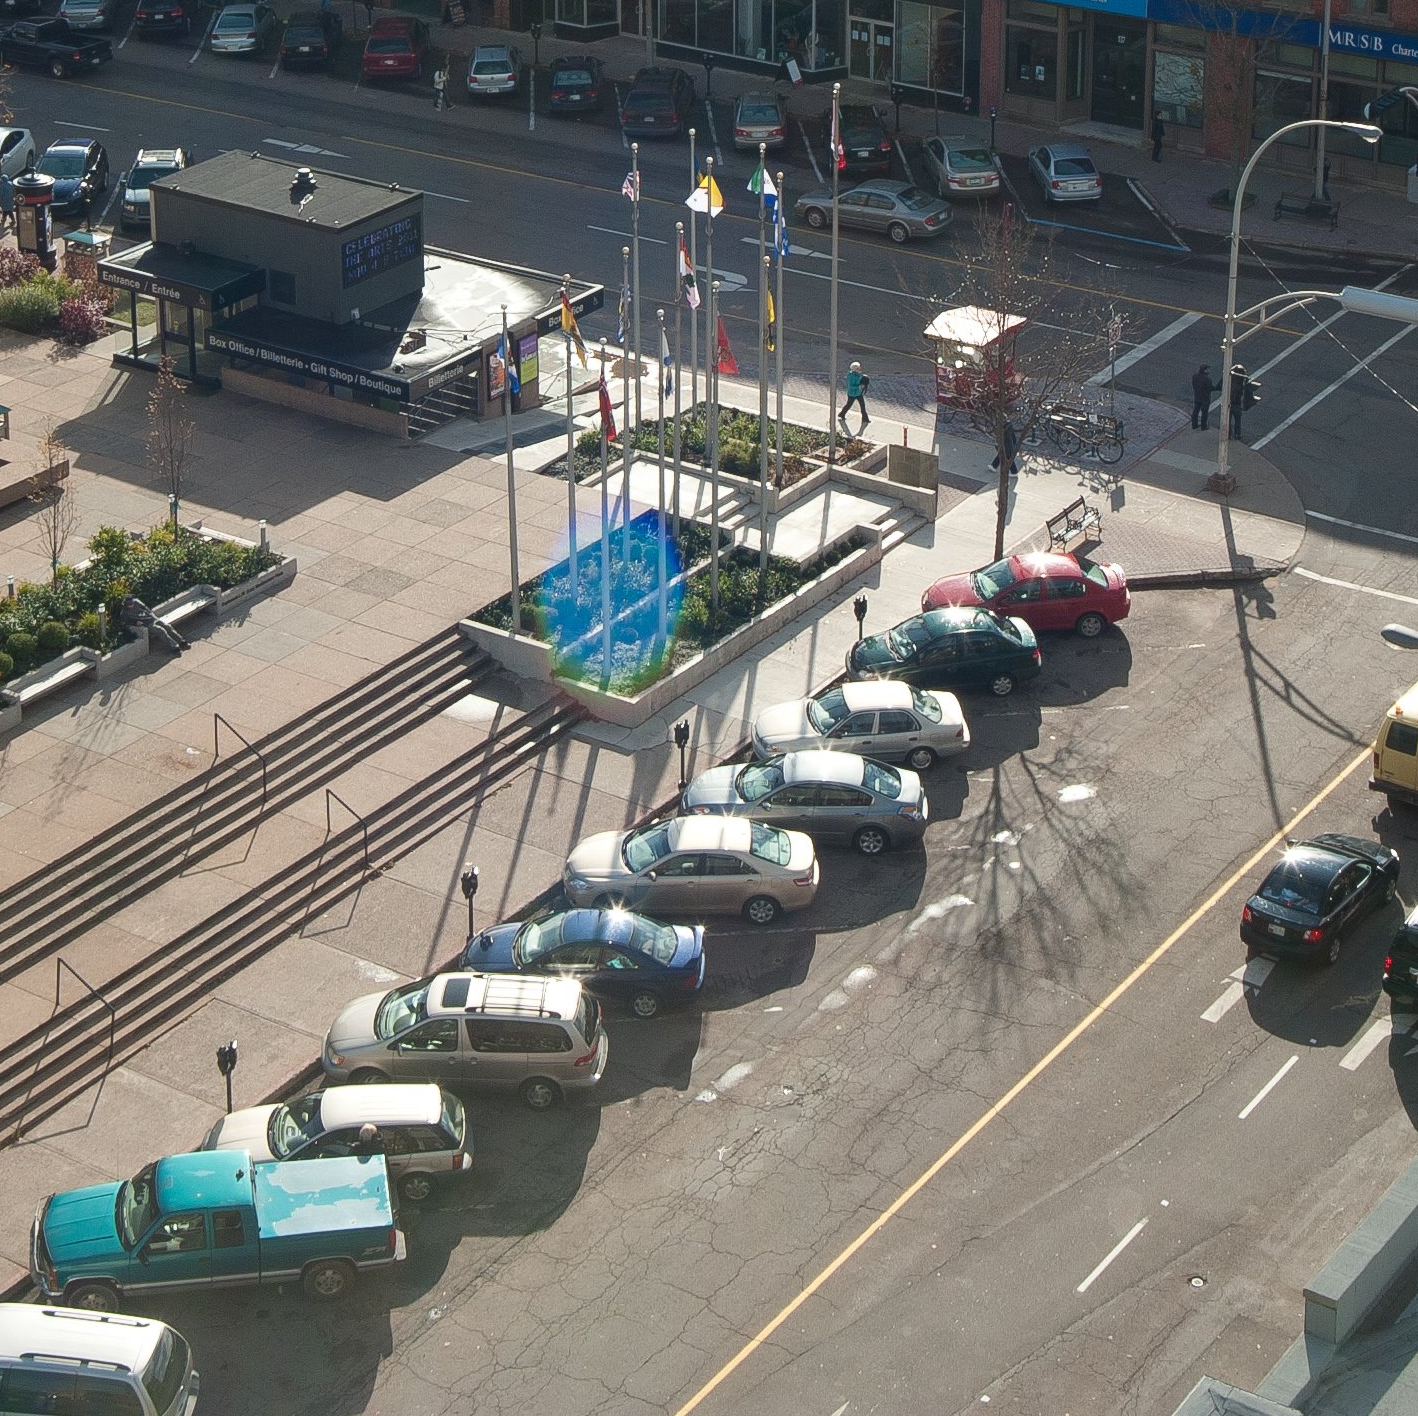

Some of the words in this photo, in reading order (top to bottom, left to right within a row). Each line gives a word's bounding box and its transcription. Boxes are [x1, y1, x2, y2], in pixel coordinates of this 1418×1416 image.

[102, 270, 141, 289] Entrance
[151, 283, 181, 299] Entrée
[209, 335, 227, 350] Box
[229, 340, 255, 357] Office
[261, 349, 304, 370] Billetterie
[310, 362, 328, 377] Gift
[329, 367, 353, 385] Shop
[359, 375, 402, 397] Boutique
[428, 364, 465, 389] Billetterie
